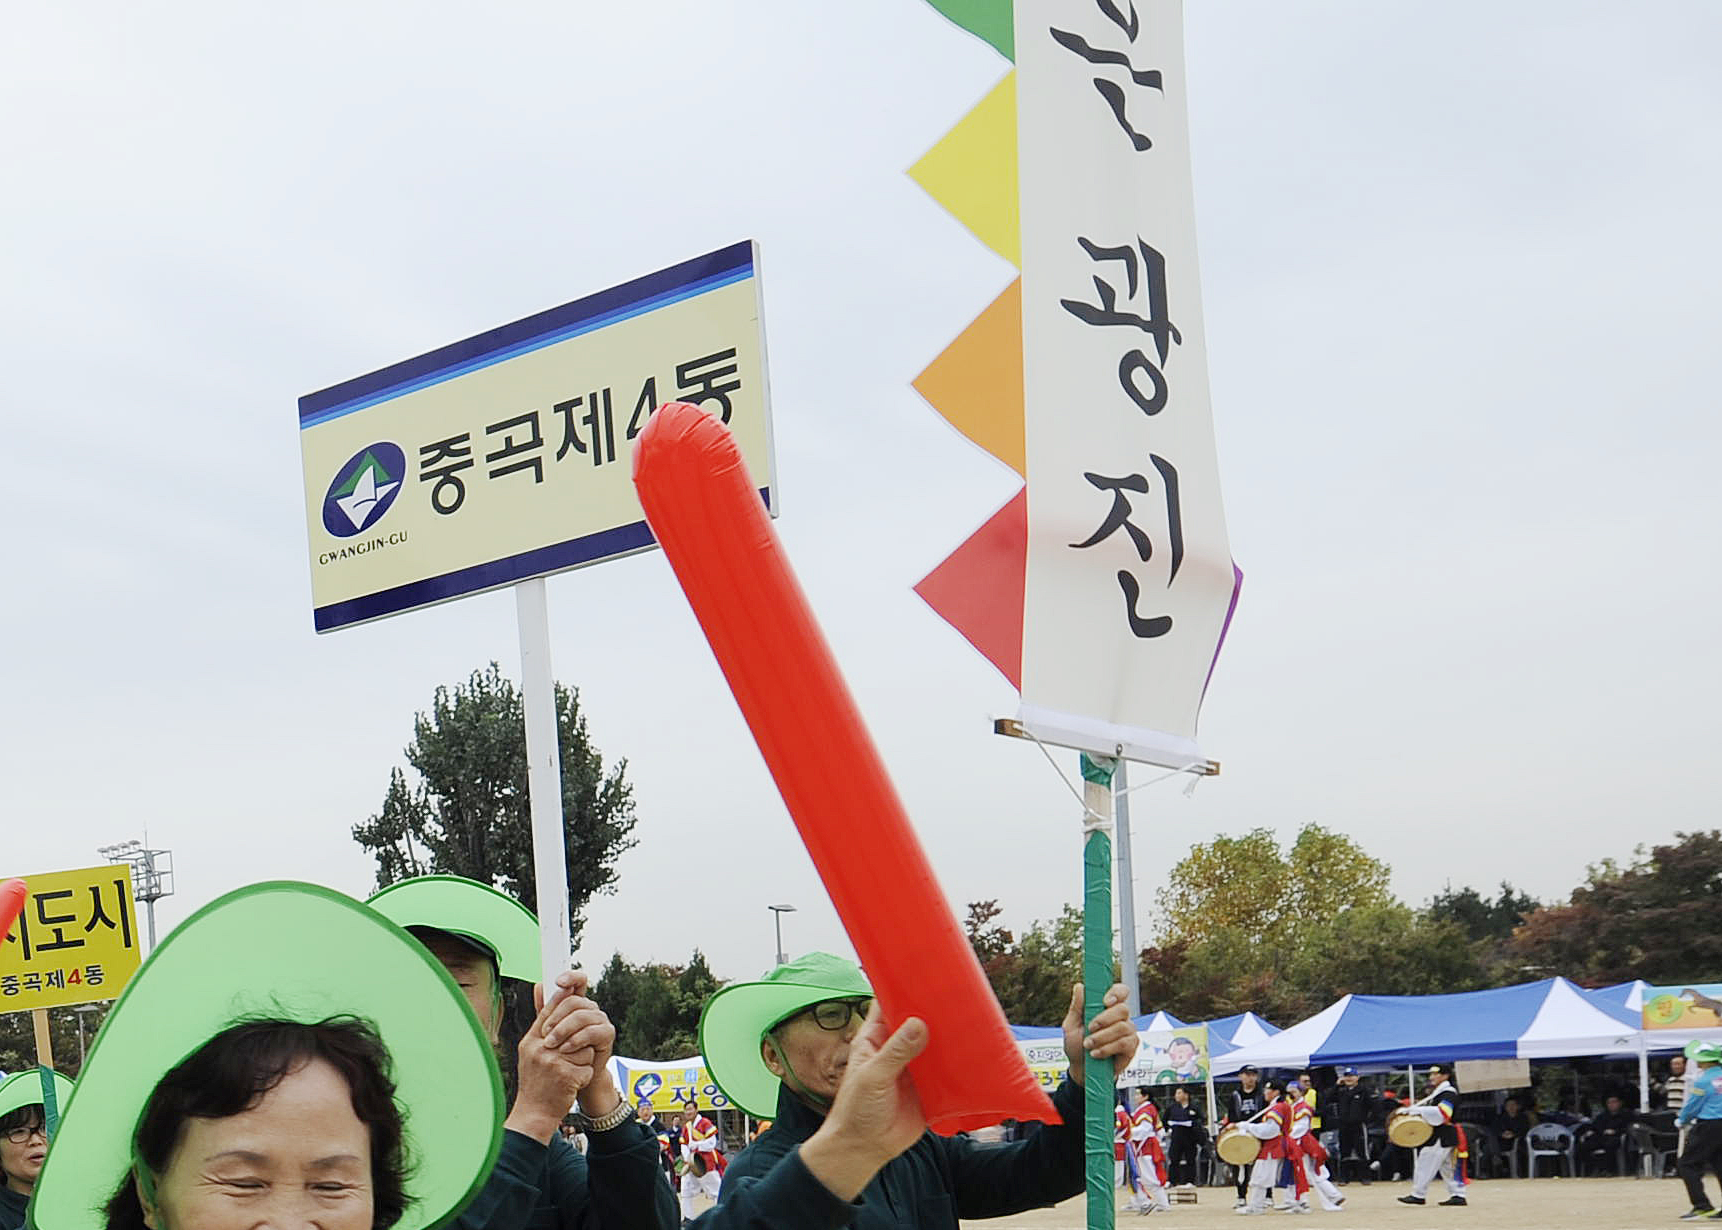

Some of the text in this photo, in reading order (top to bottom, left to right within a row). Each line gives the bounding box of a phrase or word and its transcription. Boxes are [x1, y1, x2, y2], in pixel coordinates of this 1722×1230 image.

[418, 347, 742, 516] 중곡제4동
[318, 531, 409, 566] GWANGJIN-GU
[0, 965, 105, 996] 중곡제4동
